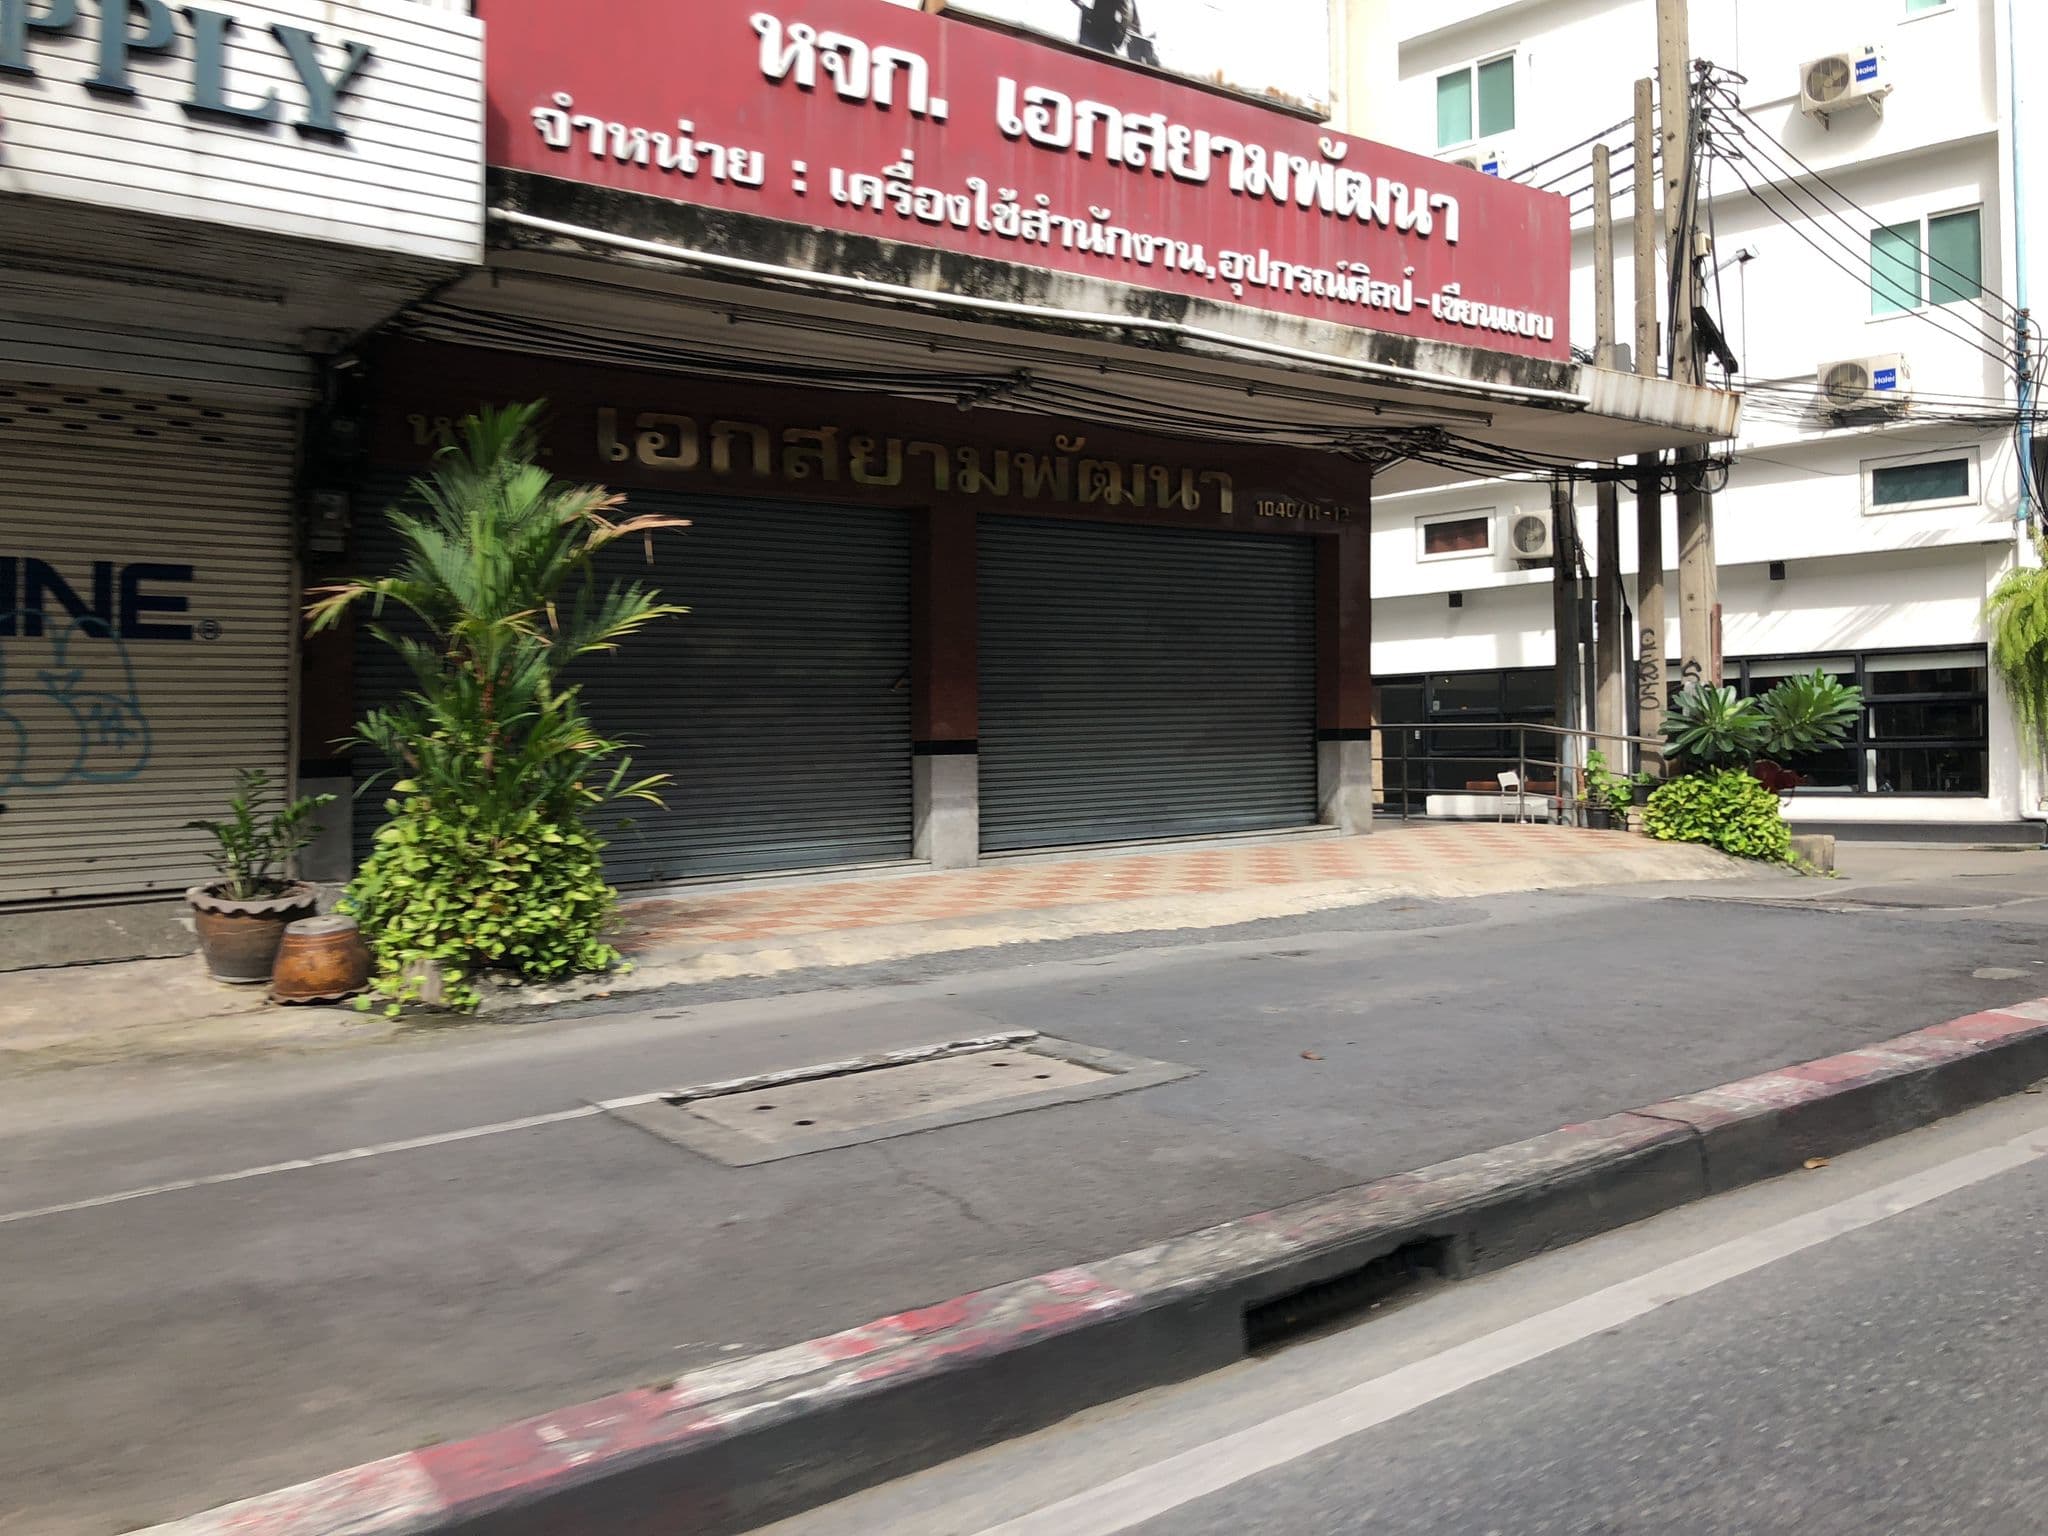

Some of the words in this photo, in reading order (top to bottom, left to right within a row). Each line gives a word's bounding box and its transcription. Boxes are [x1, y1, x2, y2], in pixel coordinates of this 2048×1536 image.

[531, 92, 764, 187] จำหน่าย
[750, 12, 949, 121] หจก.
[996, 75, 1460, 243] เอกสยามพัฒนา
[597, 405, 1233, 515] เอกสยามพัฒนา
